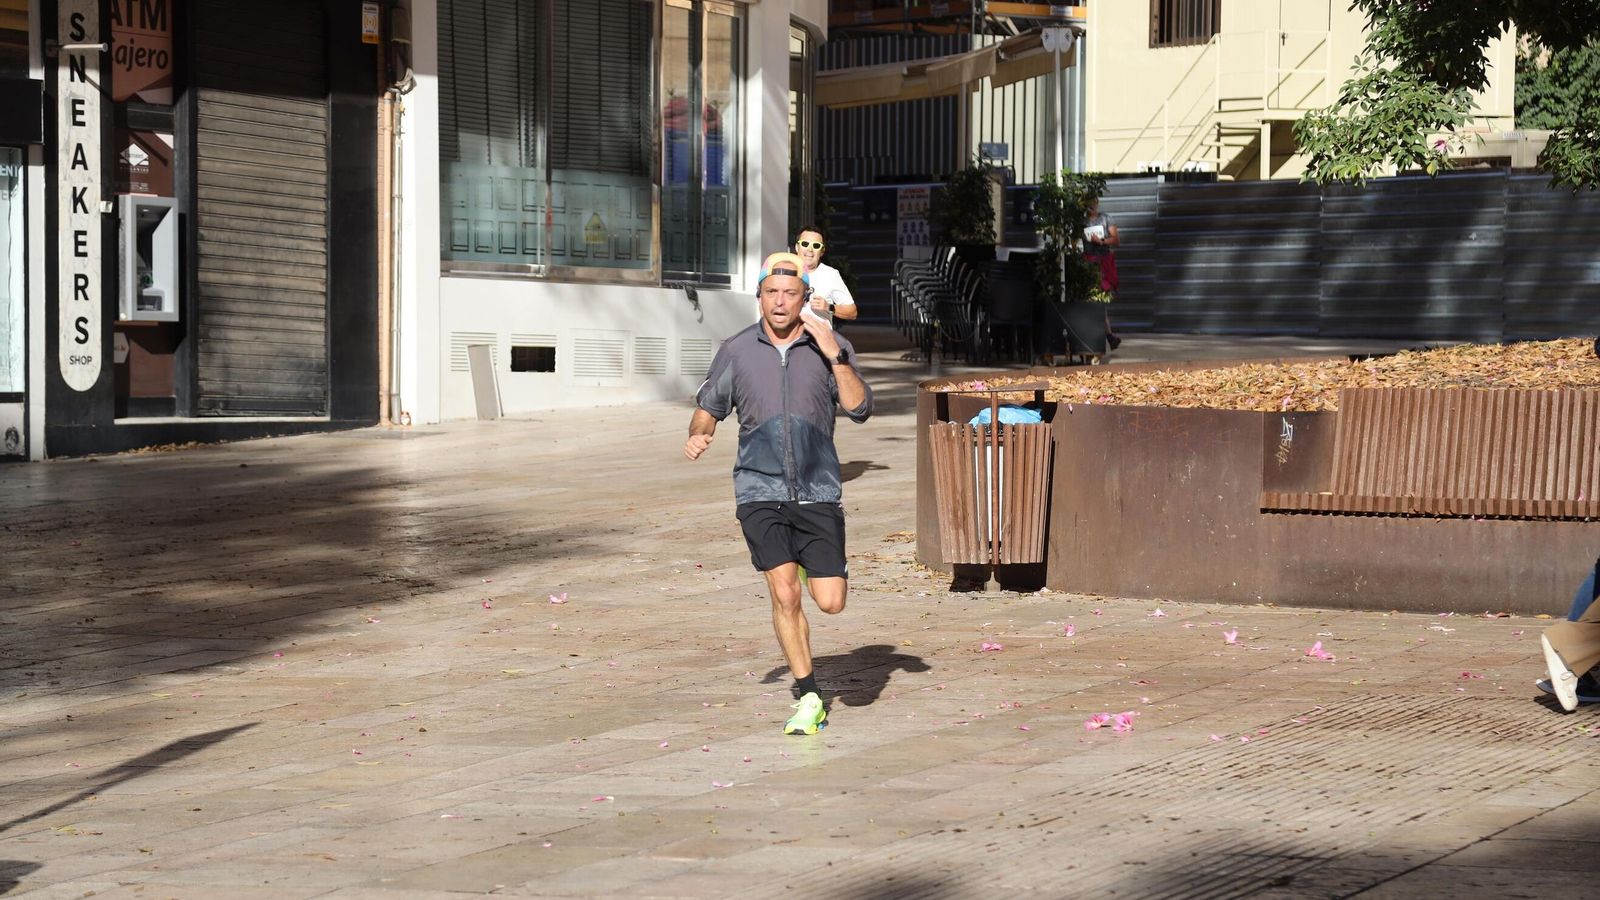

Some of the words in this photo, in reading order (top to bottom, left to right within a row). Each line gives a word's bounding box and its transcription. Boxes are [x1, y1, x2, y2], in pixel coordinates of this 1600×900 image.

[112, 37, 168, 72] ajero
[69, 12, 89, 345] SNEAKERS
[69, 355, 92, 366] SHOP
